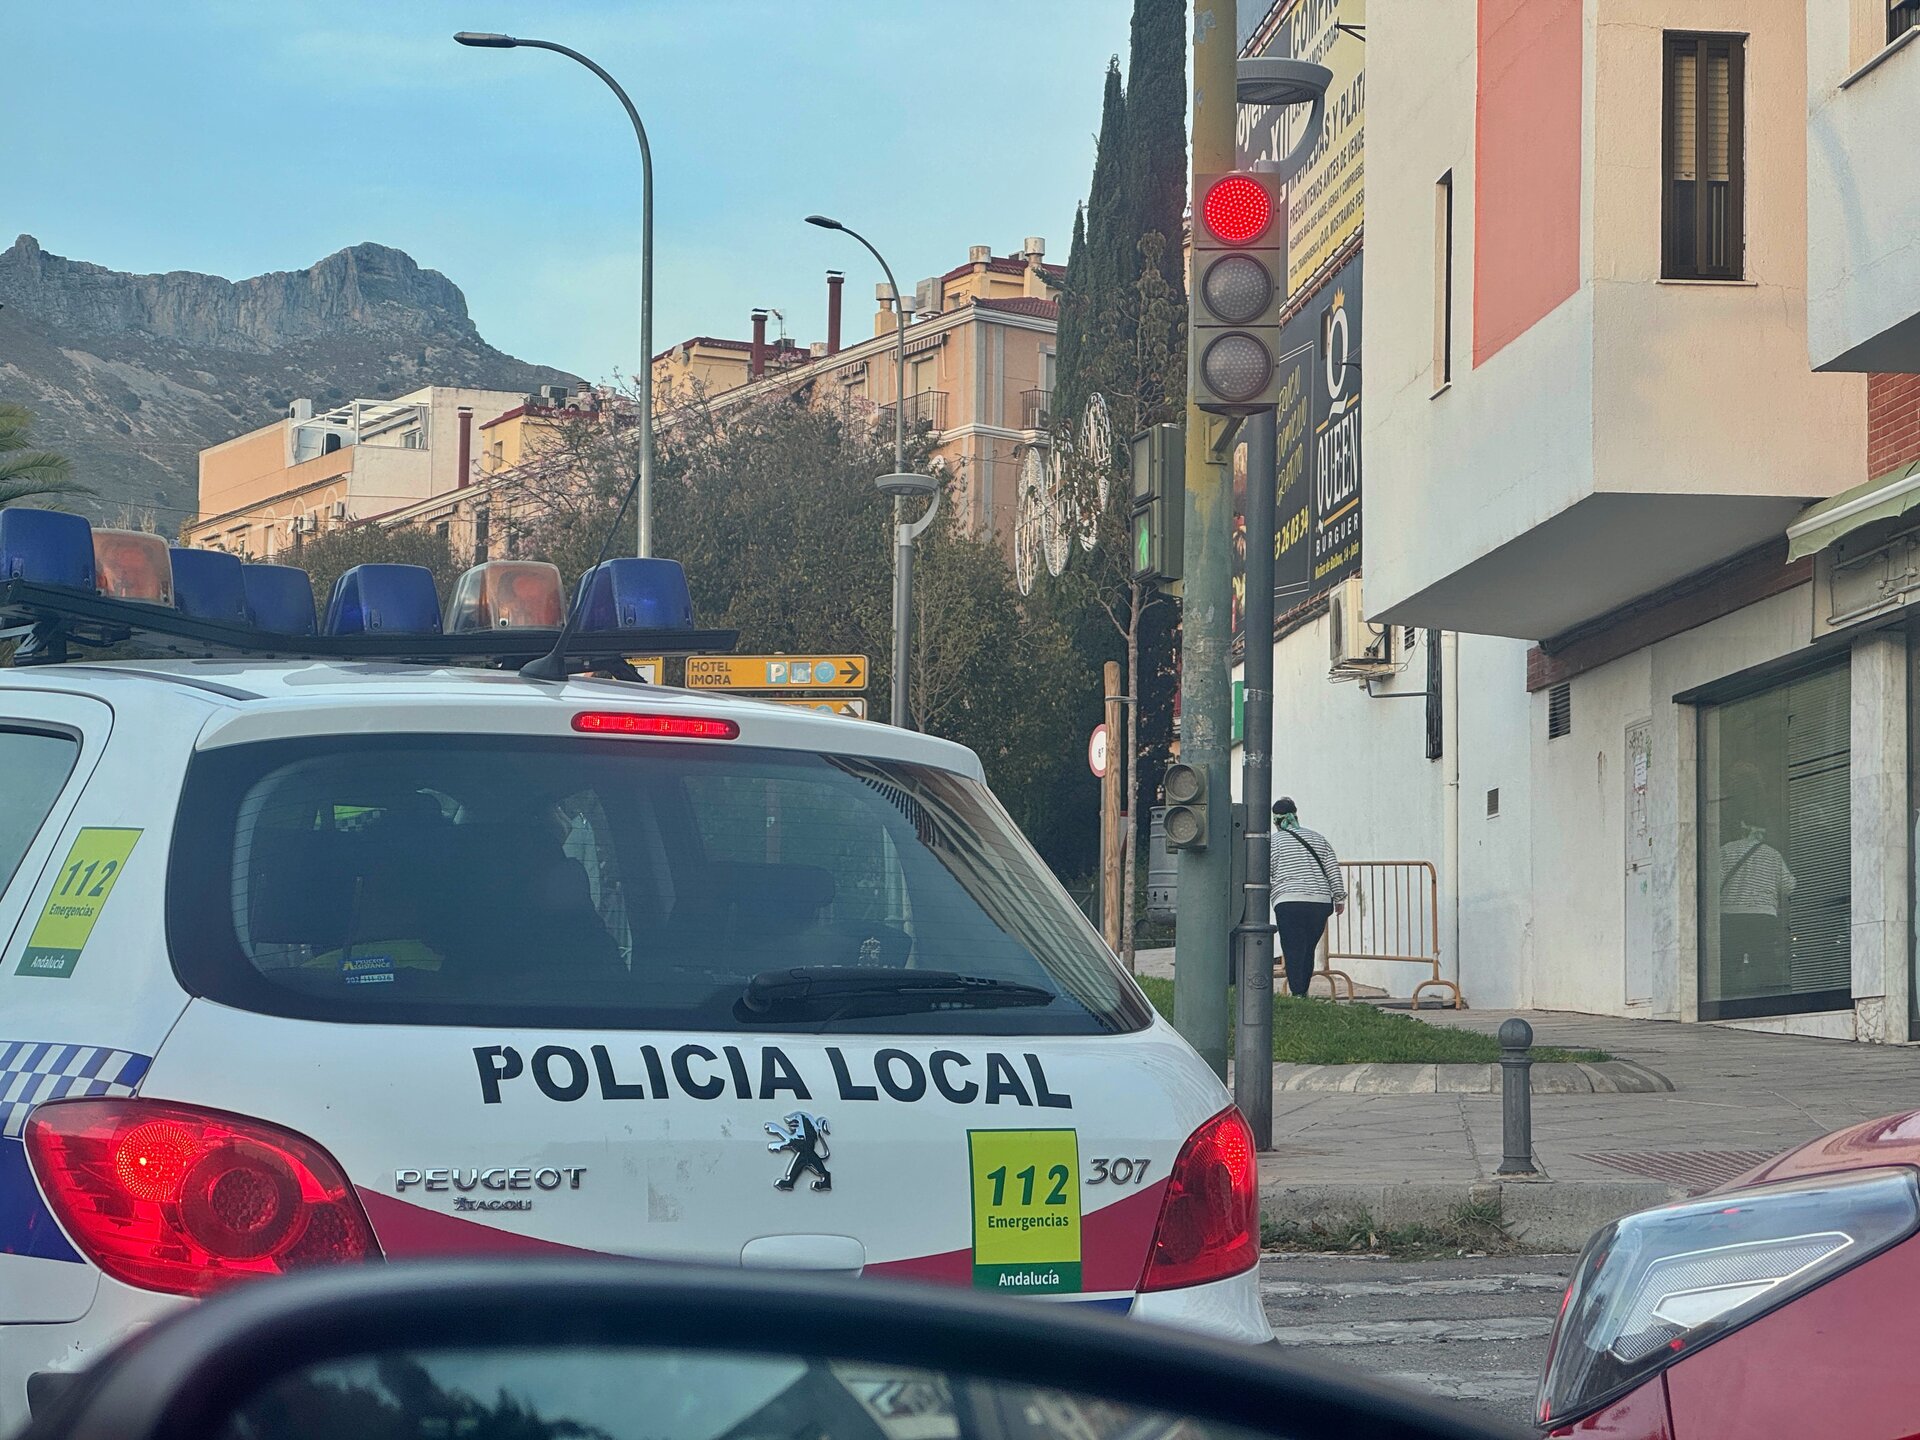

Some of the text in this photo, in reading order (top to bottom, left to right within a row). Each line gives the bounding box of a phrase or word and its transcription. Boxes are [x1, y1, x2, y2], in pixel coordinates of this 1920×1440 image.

[1332, 100, 1339, 142] Y
[1323, 155, 1339, 192] ANTES
[1340, 146, 1347, 172] DE
[1281, 521, 1290, 554] 26
[1290, 513, 1299, 546] 03
[1316, 512, 1359, 557] BURGUER
[691, 661, 732, 673] HOTEL
[691, 675, 731, 686] IMORA
[59, 859, 118, 897] 112
[48, 903, 95, 918] Emergencias
[31, 954, 65, 970] Andalucía
[472, 1043, 1073, 1109] POLICIA LOCAL
[394, 1167, 587, 1191] PEUGEOT
[986, 1164, 1070, 1206] 112
[1085, 1158, 1152, 1185] 307
[987, 1213, 1069, 1231] Emergencias
[998, 1269, 1060, 1287] Andalucía
